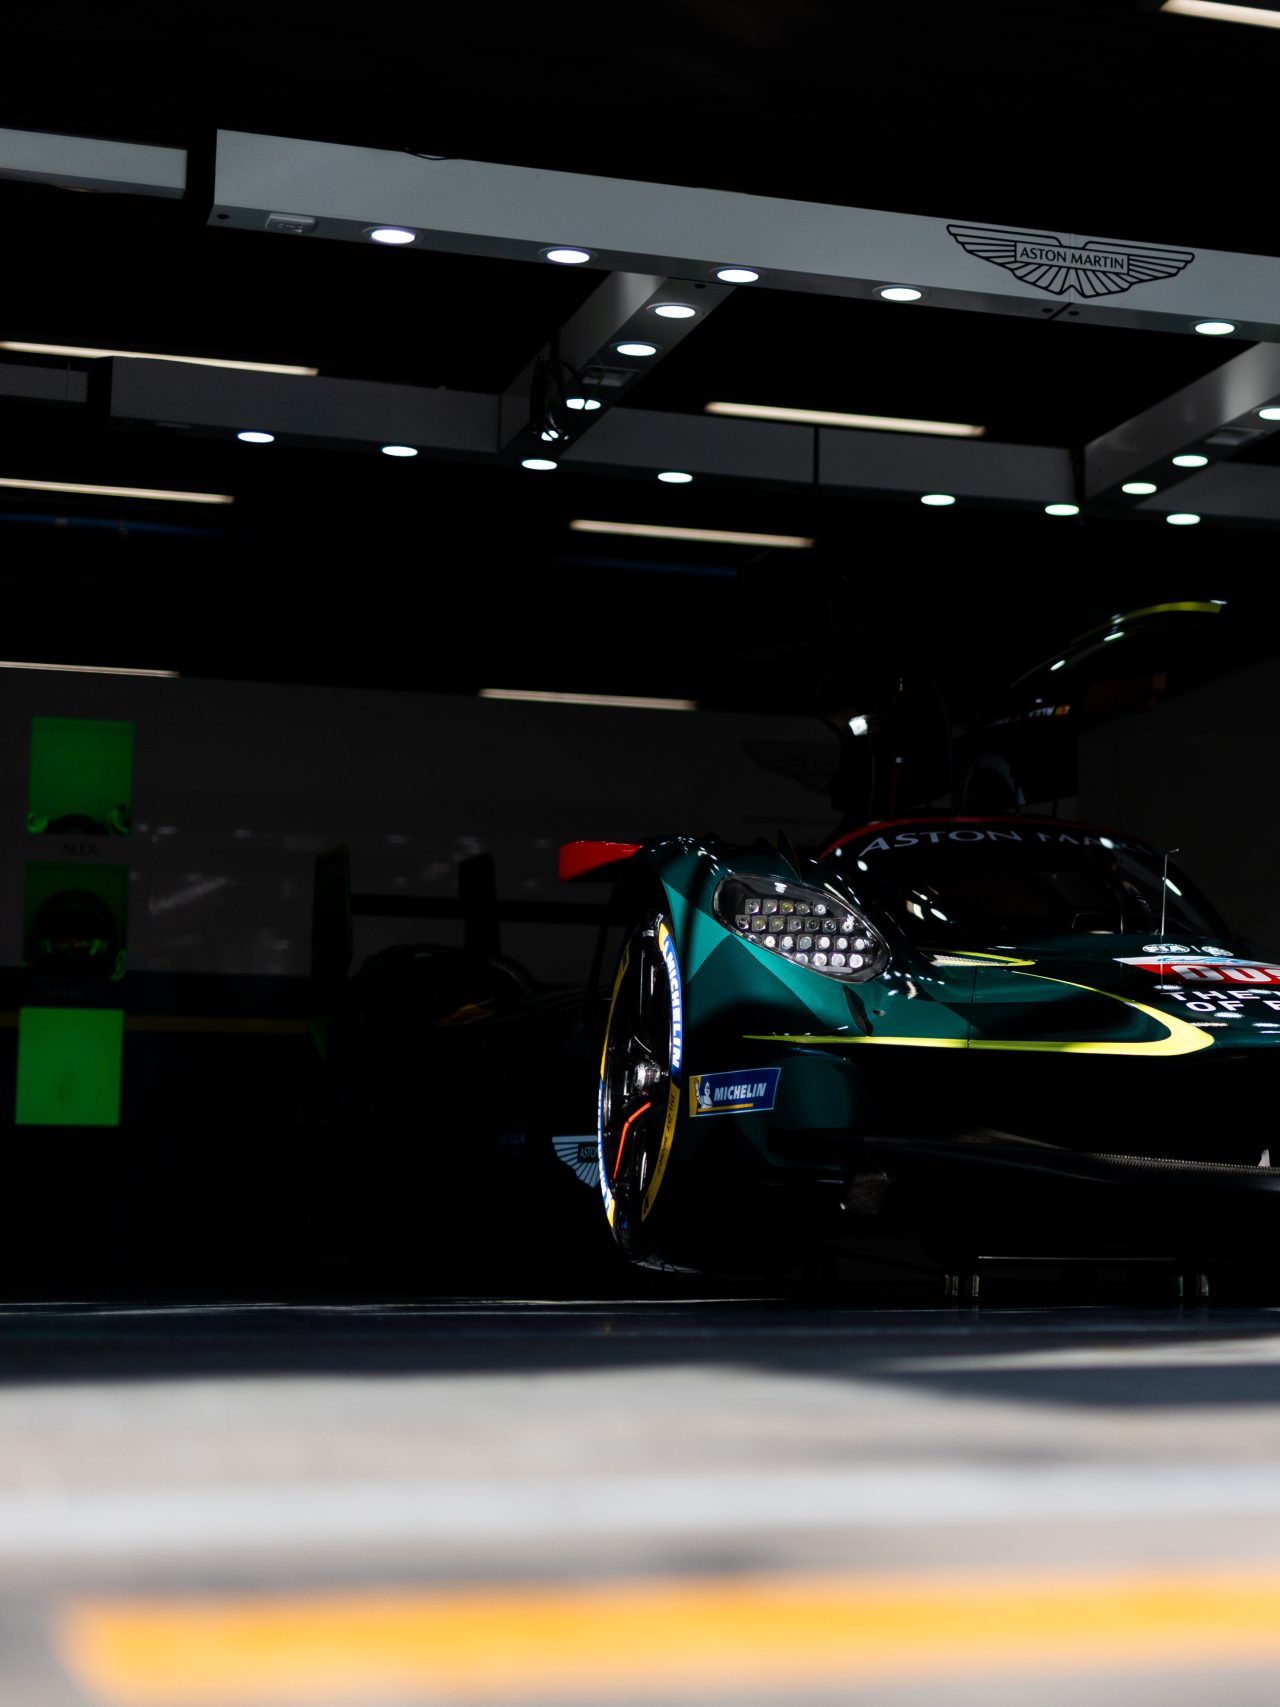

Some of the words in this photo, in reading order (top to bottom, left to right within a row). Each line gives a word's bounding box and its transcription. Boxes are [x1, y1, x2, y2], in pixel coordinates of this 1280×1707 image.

[1020, 246, 1067, 263] ASTON
[1070, 251, 1125, 270] MARTIN
[857, 830, 1023, 858] ASTON
[1160, 990, 1261, 1001] THE
[665, 951, 682, 1069] MICHELIN
[1185, 1000, 1245, 1012] OF
[713, 1082, 767, 1102] MICHELIN
[580, 1146, 598, 1159] ASTO
